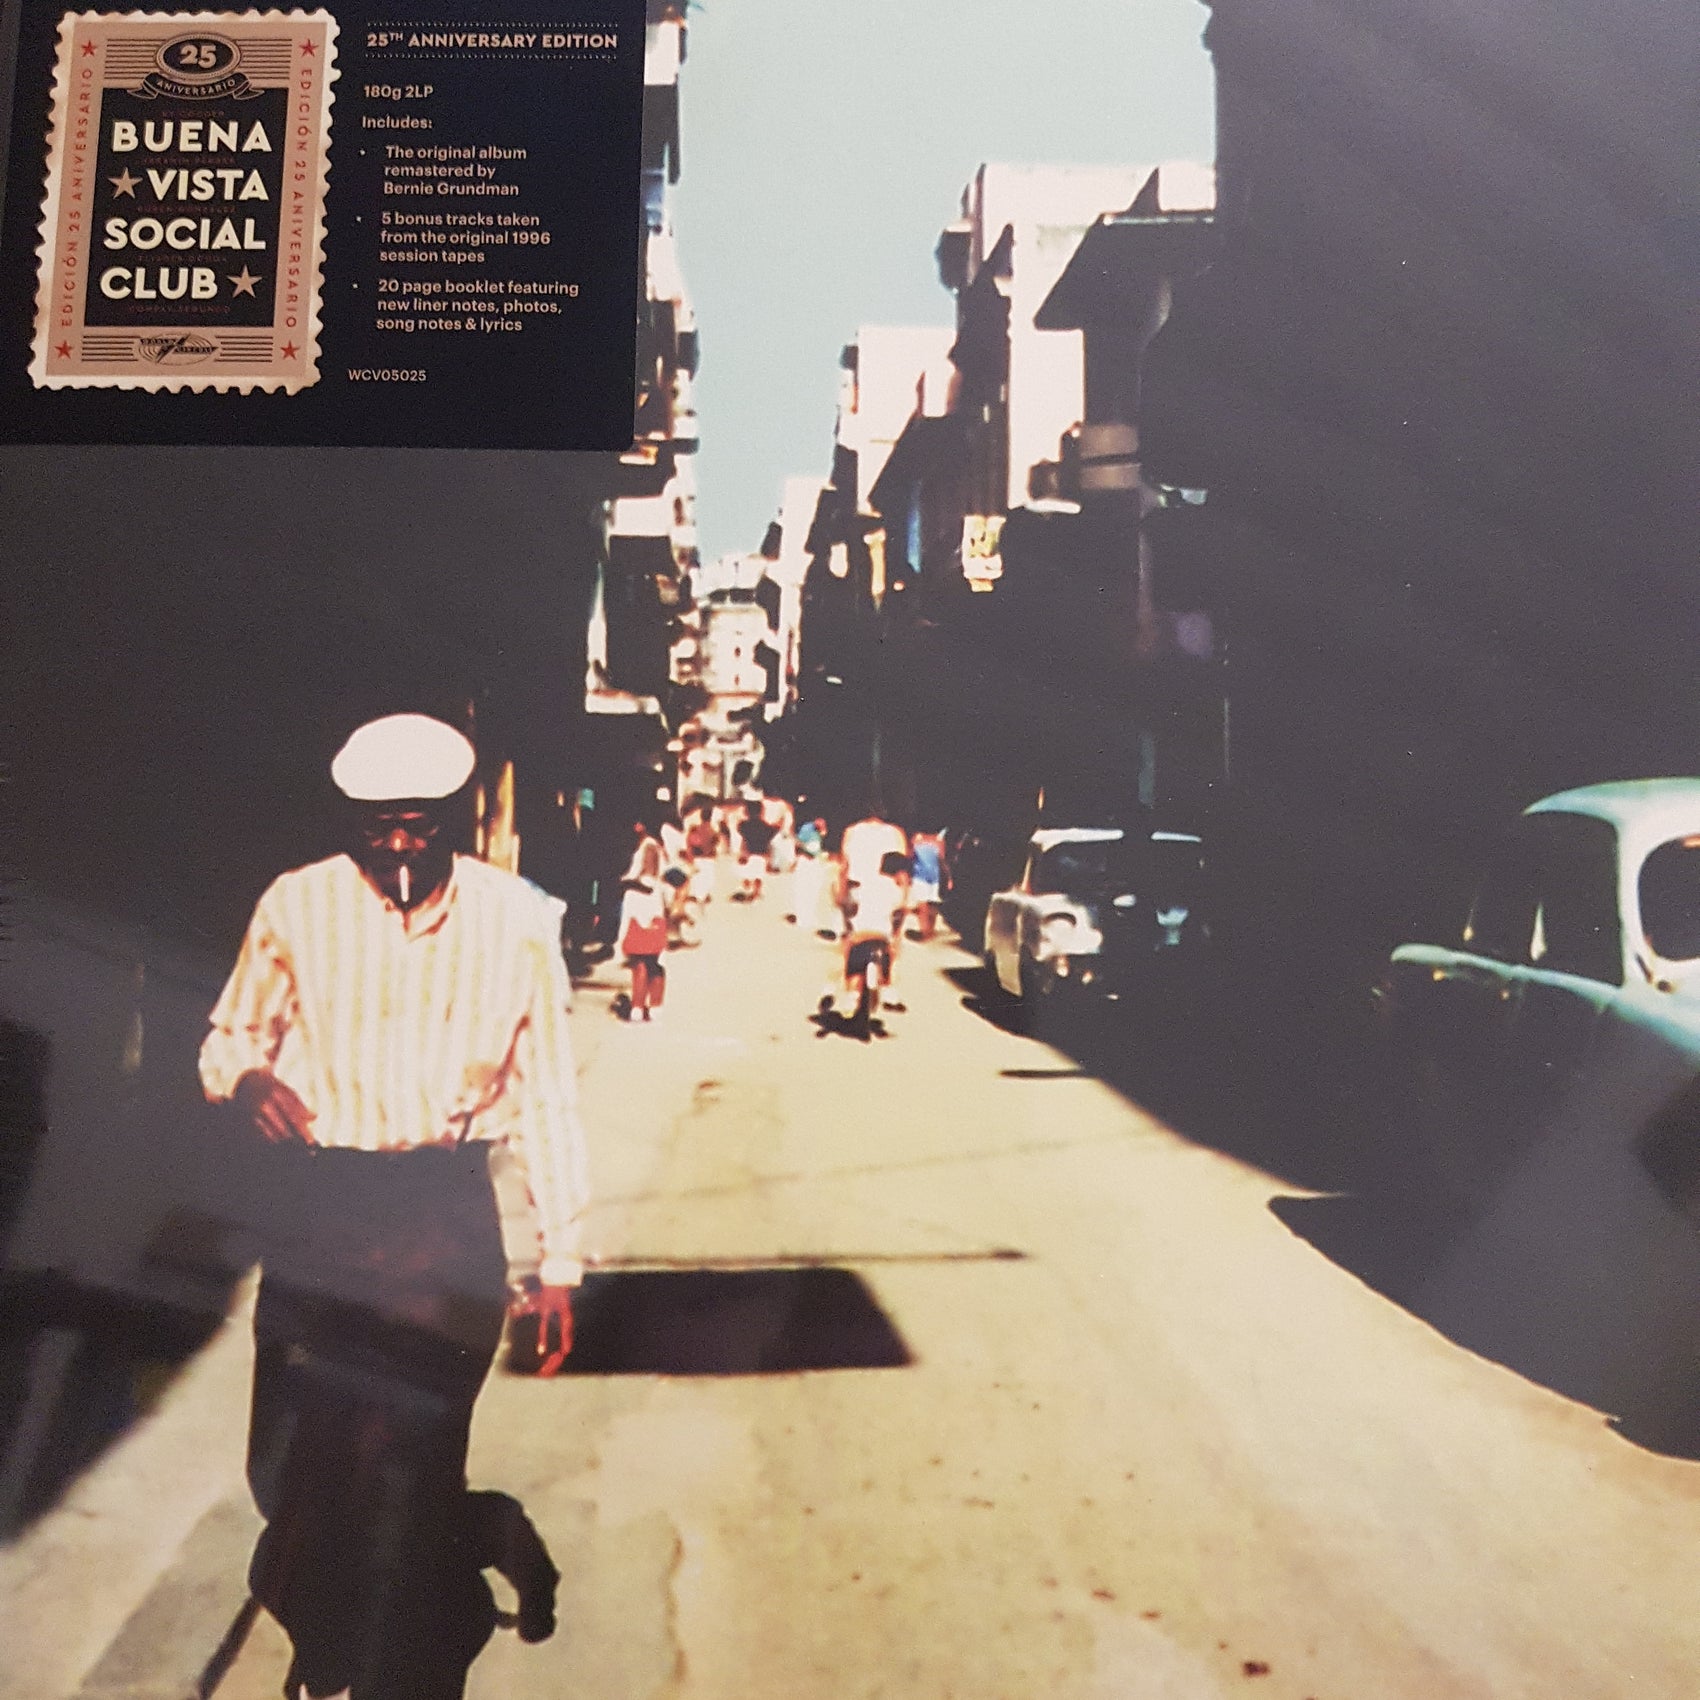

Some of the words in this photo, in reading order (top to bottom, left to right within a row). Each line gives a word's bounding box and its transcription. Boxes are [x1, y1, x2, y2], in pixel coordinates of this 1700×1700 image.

[407, 32, 537, 48] ANNIVERSARY
[541, 33, 618, 49] EDITION
[179, 43, 218, 69] 25
[156, 77, 236, 97] ANIVERSARIO
[363, 84, 402, 101] 180g
[405, 84, 434, 98] 2LP
[296, 69, 313, 151] EDICIÓN
[362, 115, 433, 129] Includes:
[72, 68, 93, 201] ANIVERSARIO
[111, 119, 273, 153] BUENA
[385, 144, 415, 159] The
[416, 145, 476, 162] original
[478, 145, 527, 160] album
[294, 160, 306, 182] 25
[384, 163, 474, 178] remastered
[477, 163, 496, 180] by
[146, 168, 270, 201] VISTA
[383, 181, 434, 195] Bernie
[436, 181, 519, 196] Grundman
[68, 211, 80, 231] 25
[381, 211, 392, 225] 5
[394, 211, 443, 226] bonus
[446, 211, 494, 226] tracks
[497, 212, 540, 227] taken
[103, 216, 267, 250] SOCIAL
[380, 229, 418, 244] from
[420, 229, 447, 244] the
[449, 229, 509, 247] original
[512, 231, 551, 245] 1996
[286, 191, 304, 328] ANIVERSARIO
[379, 248, 439, 262] session
[441, 250, 485, 265] tapes
[61, 241, 79, 327] EDICIÓN
[99, 266, 218, 300] CLUB
[378, 278, 400, 293] 20
[402, 281, 442, 296] page
[445, 279, 505, 294] booklet
[507, 280, 579, 298] featuring
[377, 300, 411, 311] new
[413, 297, 449, 312] liner
[451, 299, 500, 314] notes,
[503, 298, 562, 315] photos,
[376, 318, 415, 333] song
[418, 317, 462, 331] notes
[465, 317, 477, 331] &
[480, 317, 523, 334] lyrics
[348, 369, 427, 382] WCV05025
